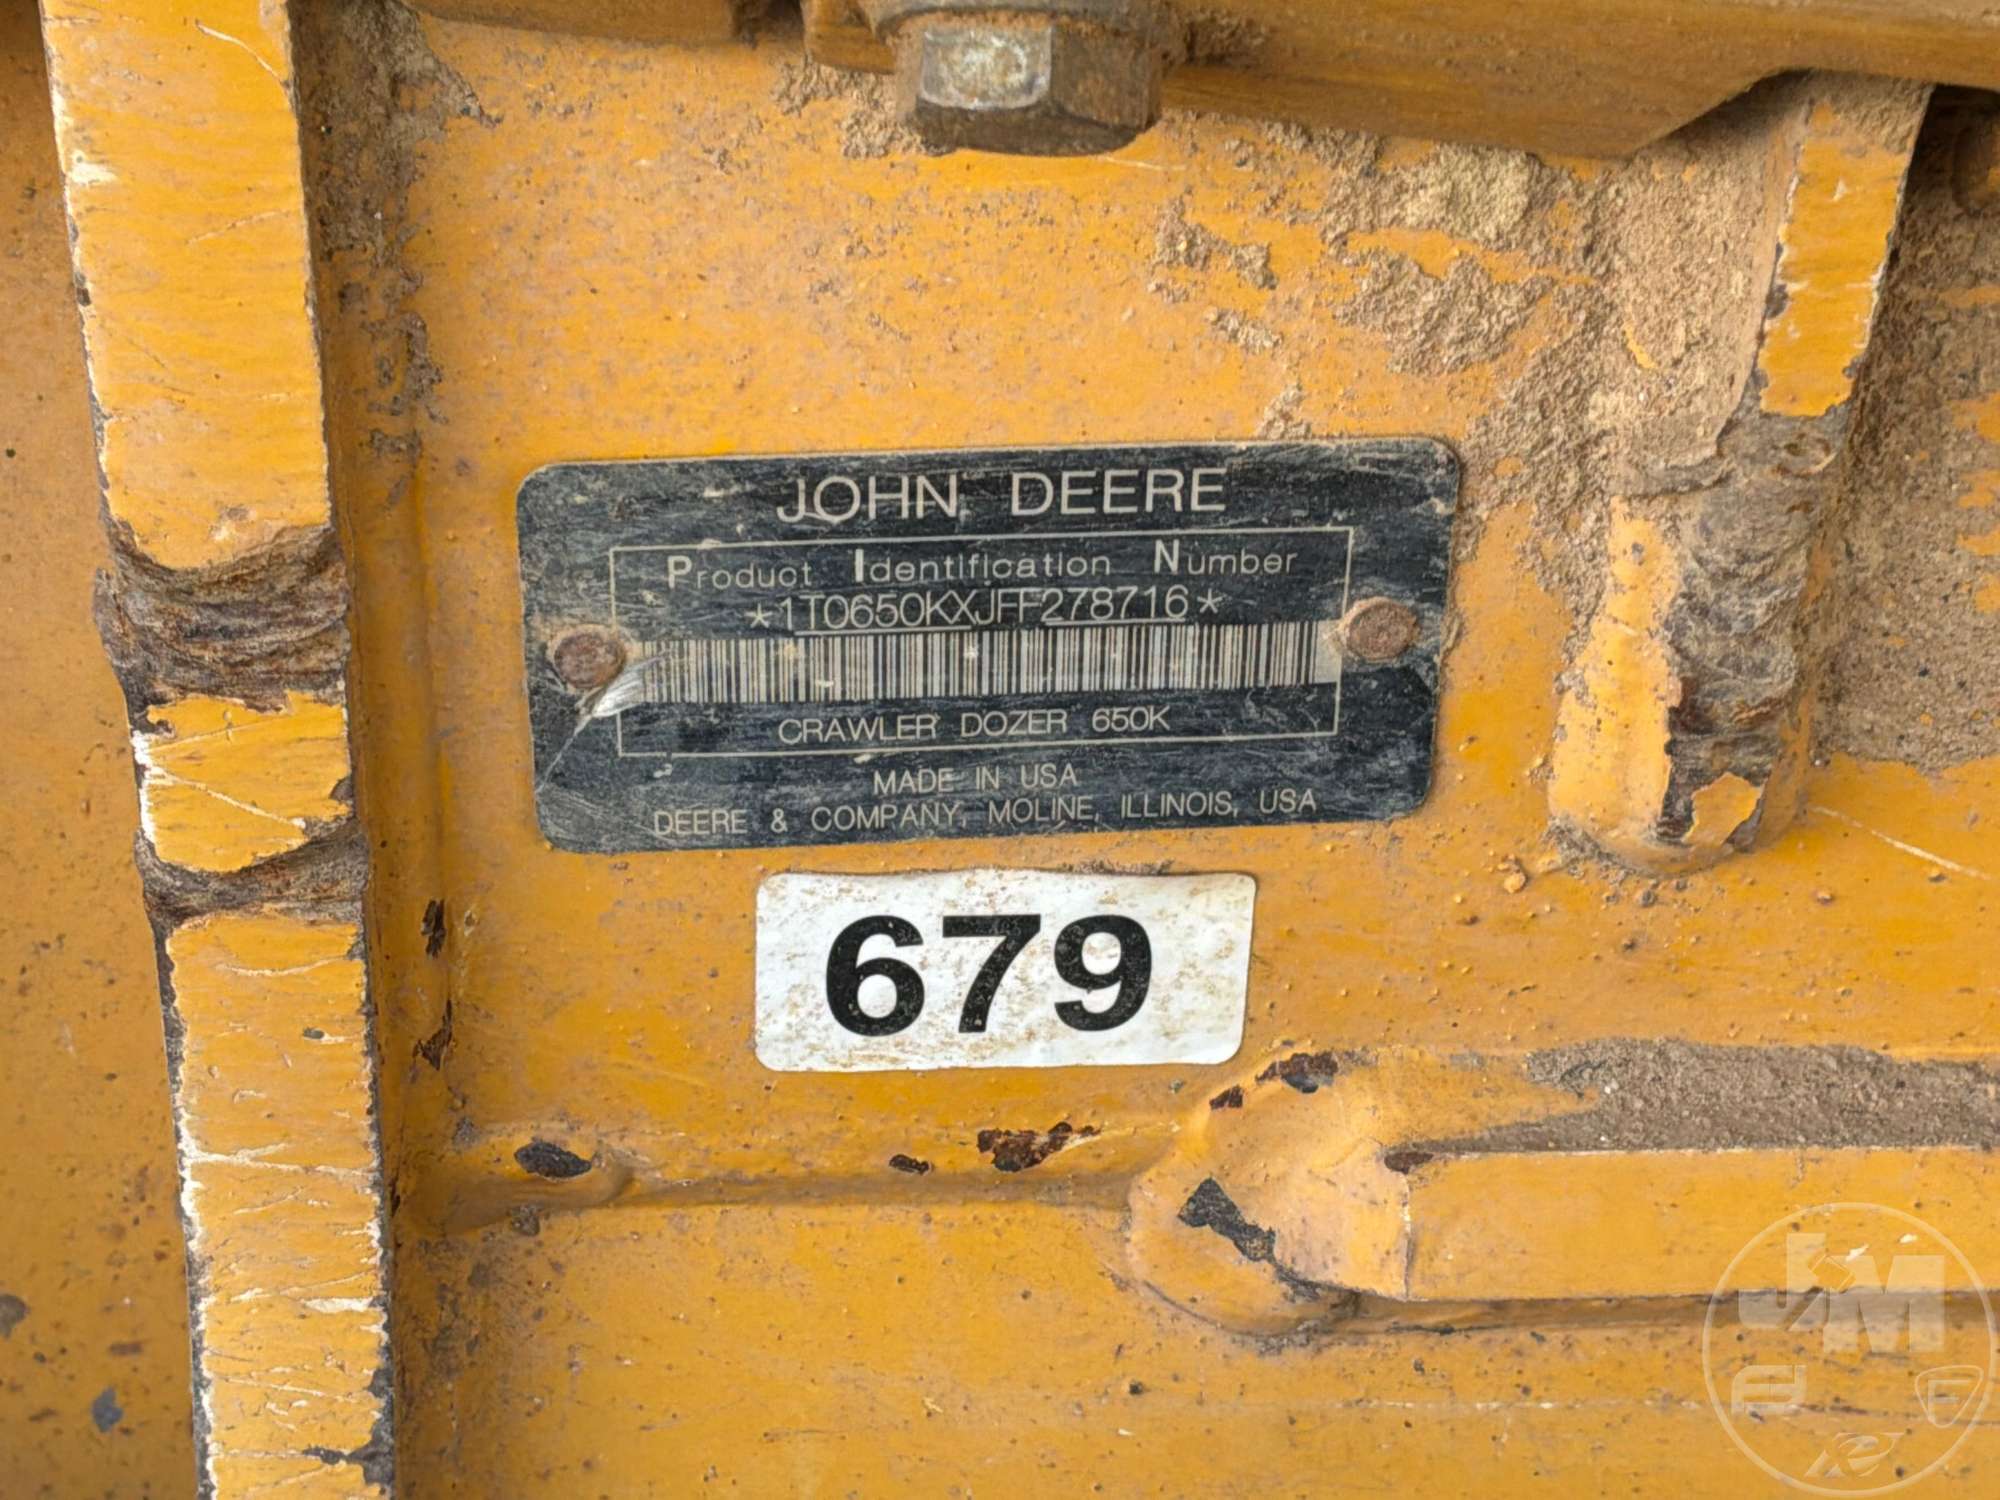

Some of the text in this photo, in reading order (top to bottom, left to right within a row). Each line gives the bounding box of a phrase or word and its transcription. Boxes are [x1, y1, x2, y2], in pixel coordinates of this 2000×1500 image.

[777, 467, 1226, 523] JOHN DEERE
[667, 539, 1298, 590] Product Identification Number
[778, 706, 1171, 744] CRAWLER DOZER 650K
[872, 764, 1078, 794] MADE IN USA
[653, 808, 748, 836] DEERE
[770, 810, 787, 833] &
[988, 796, 1100, 825] MOLINE,
[1121, 792, 1239, 818] ILLINOIS,
[1259, 789, 1317, 814] USA
[825, 913, 1152, 1036] 679
